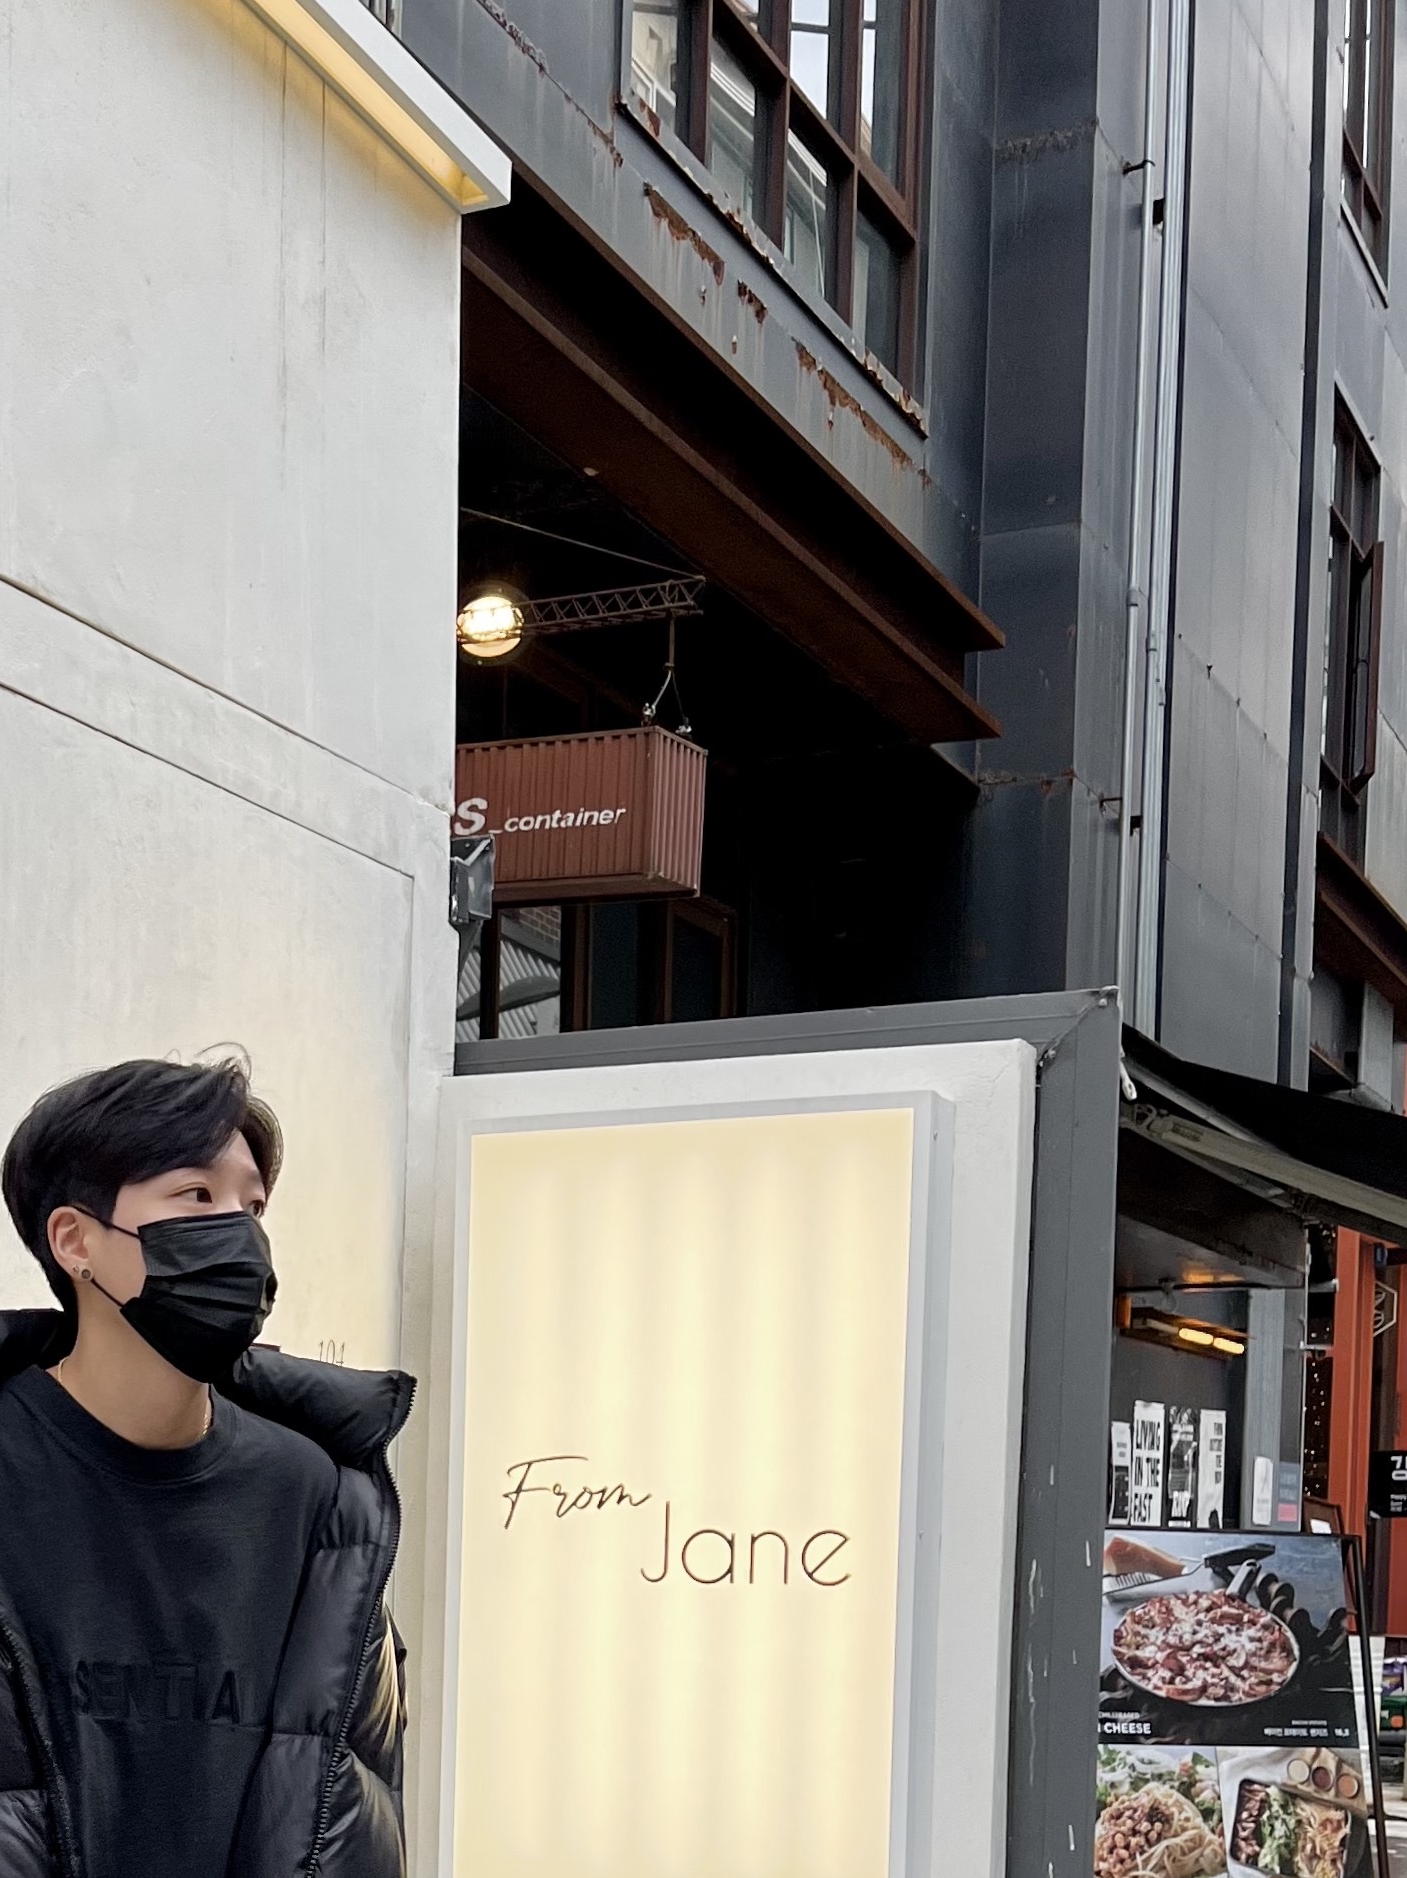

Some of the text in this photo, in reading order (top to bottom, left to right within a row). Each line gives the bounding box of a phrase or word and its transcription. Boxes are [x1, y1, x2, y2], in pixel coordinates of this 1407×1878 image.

[1135, 1420, 1161, 1452] LIVING
[1134, 1456, 1160, 1488] IN THE
[502, 1456, 651, 1530] From
[1133, 1492, 1153, 1523] FAST
[640, 1500, 852, 1587] Jane
[1103, 1722, 1152, 1735] CHEESE
